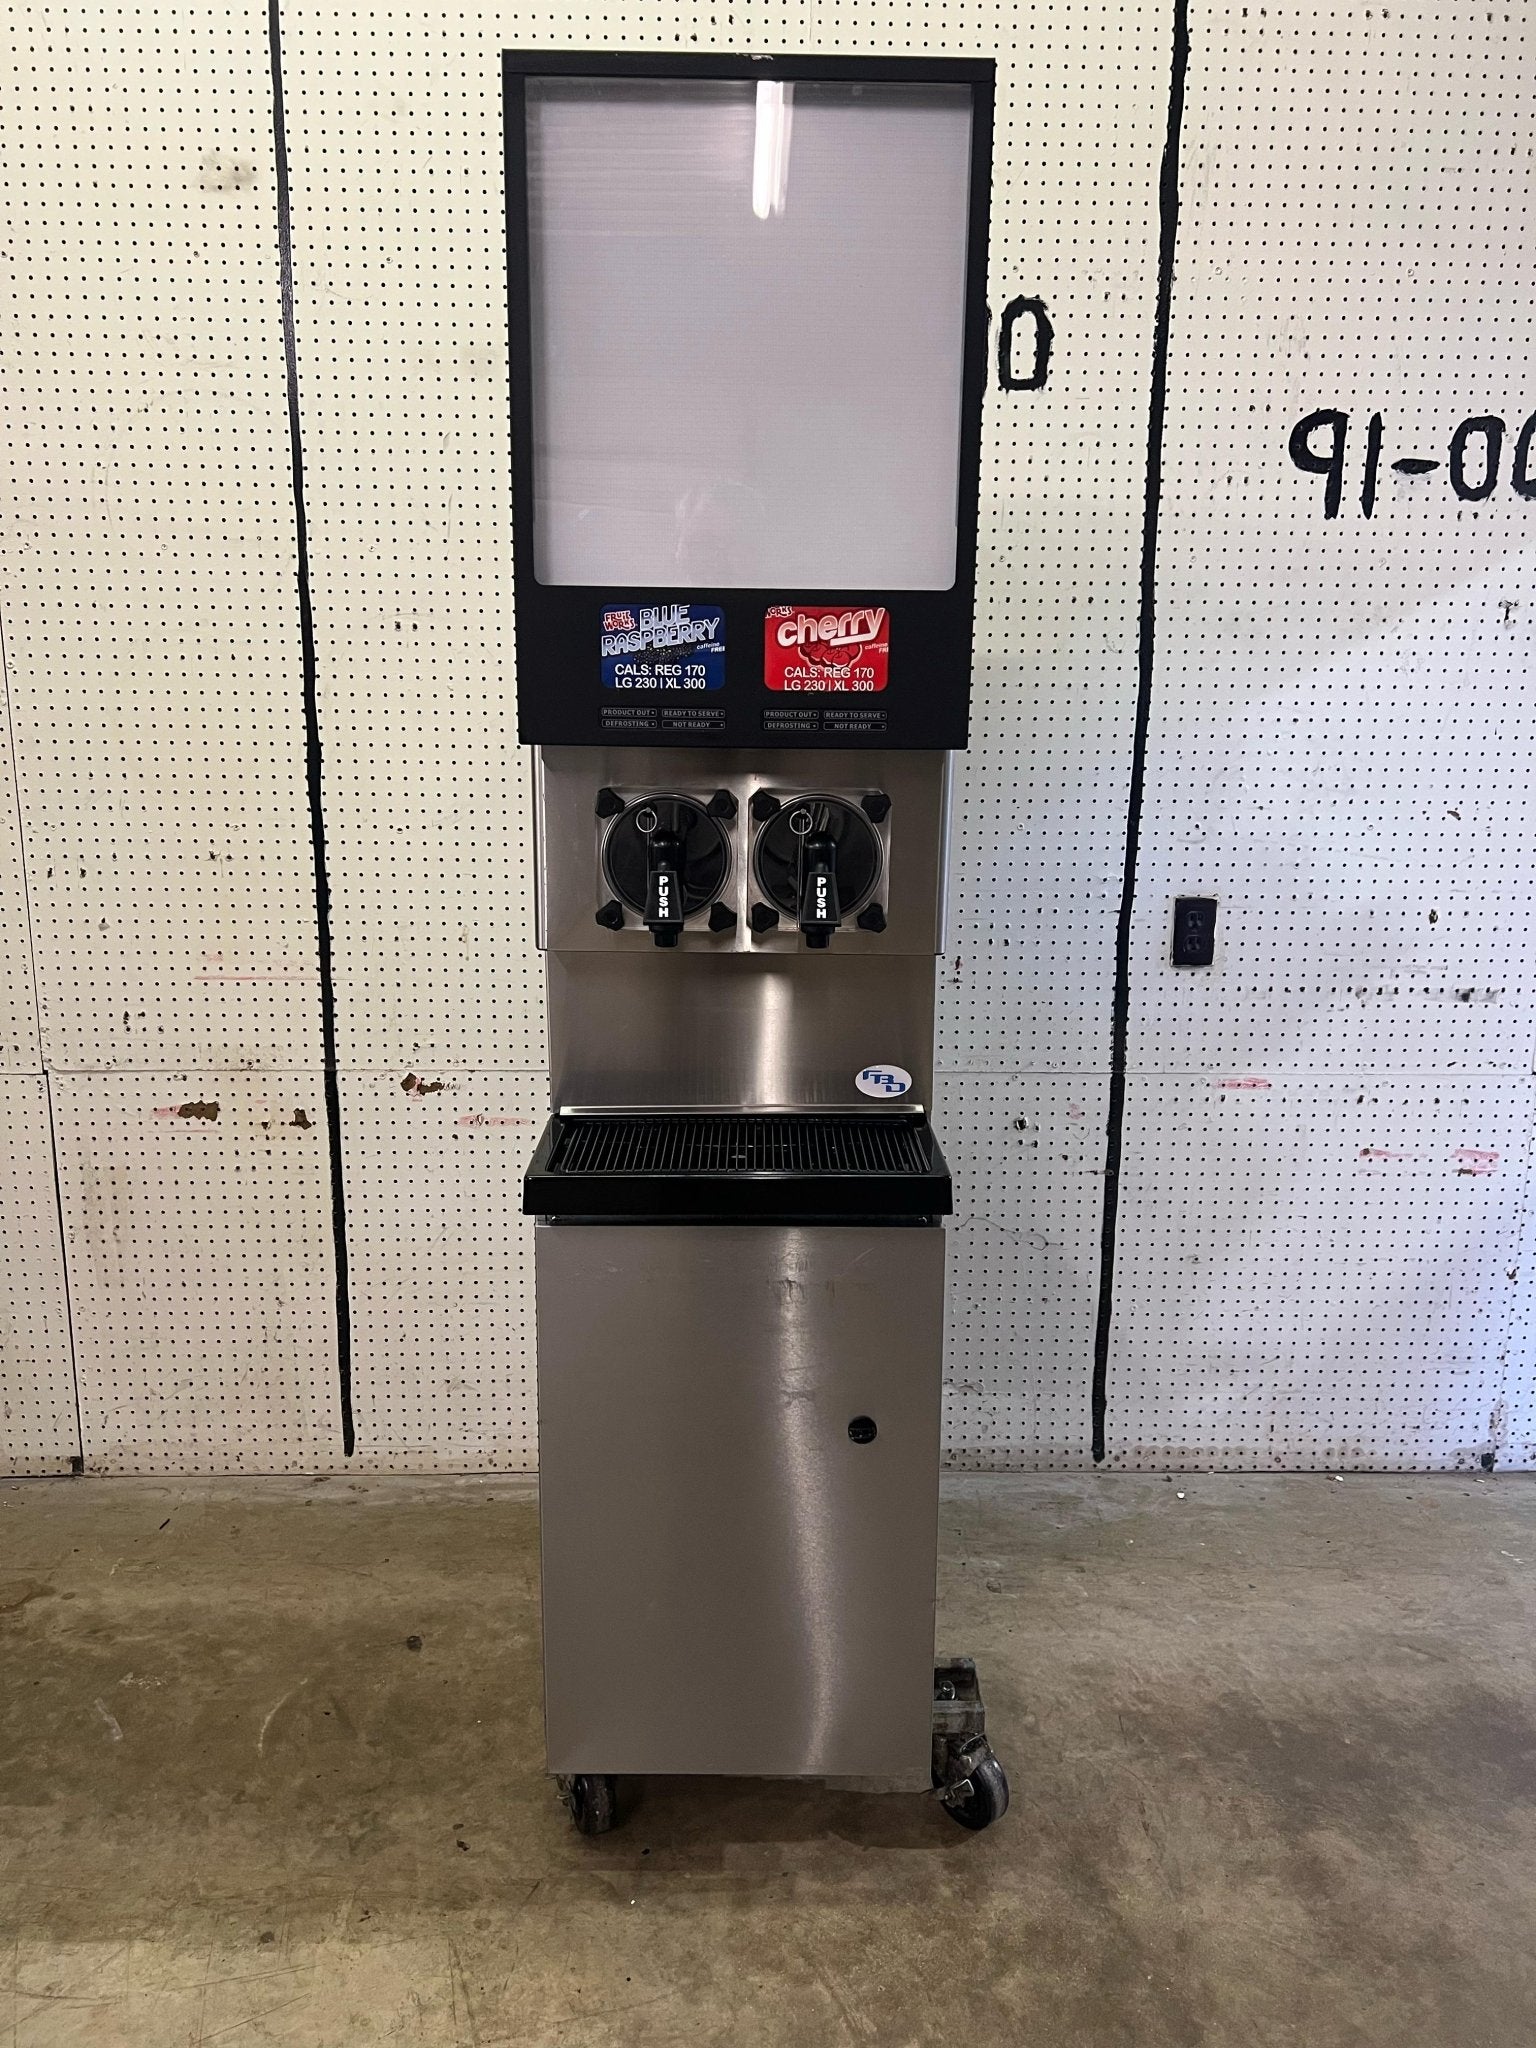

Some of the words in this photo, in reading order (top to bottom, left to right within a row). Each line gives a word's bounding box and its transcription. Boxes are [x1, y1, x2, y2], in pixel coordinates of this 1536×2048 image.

[984, 294, 1055, 393] 0
[640, 604, 690, 630] BLUE
[766, 606, 793, 618] ORKS
[603, 619, 635, 631] WORKS
[777, 607, 886, 647] cherry
[601, 617, 720, 657] RASPBERRY
[615, 664, 652, 676] CALS:
[655, 664, 682, 676] REG
[685, 665, 706, 676] 170
[784, 666, 821, 678] CALS:
[823, 667, 851, 678] REG
[854, 667, 875, 678] 170
[615, 677, 632, 688] LG
[635, 678, 657, 689] 230
[665, 678, 681, 689] XL
[683, 678, 706, 689] 300
[784, 679, 801, 691] LG
[803, 680, 826, 691] 230
[833, 680, 849, 691] XL
[852, 680, 874, 691] 300
[659, 875, 669, 918] PUSH
[816, 876, 827, 919] PUSH
